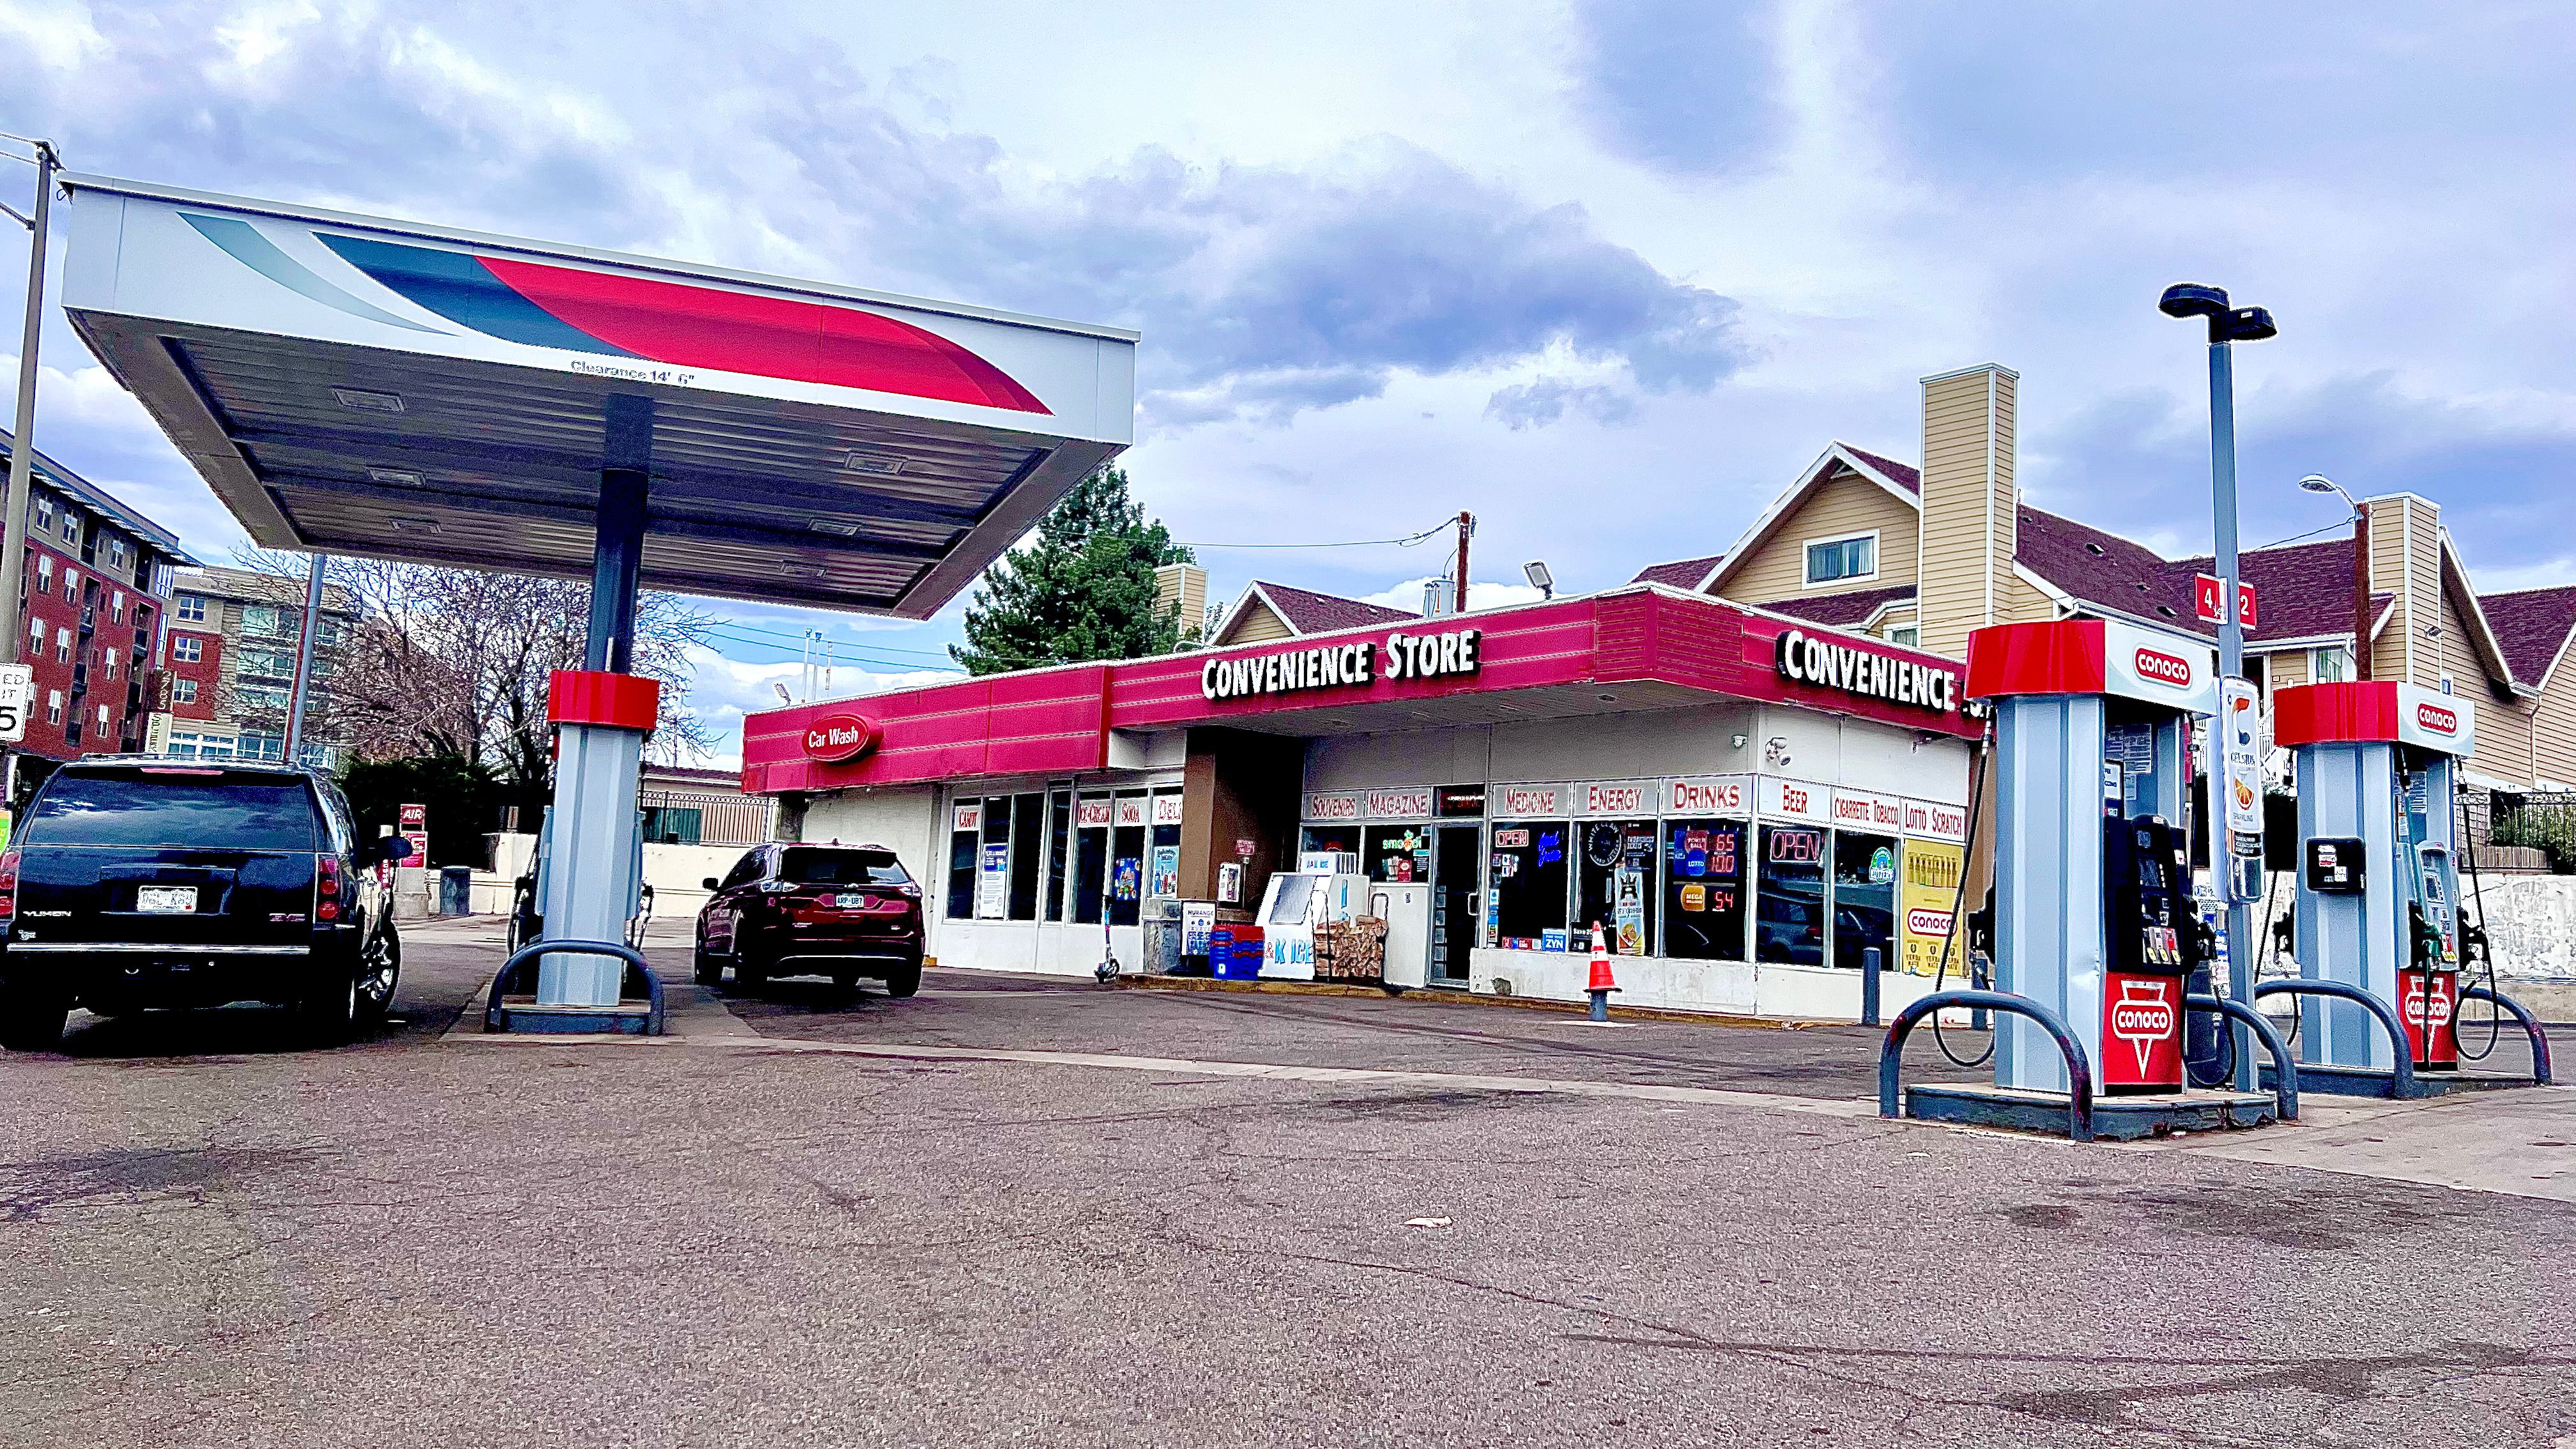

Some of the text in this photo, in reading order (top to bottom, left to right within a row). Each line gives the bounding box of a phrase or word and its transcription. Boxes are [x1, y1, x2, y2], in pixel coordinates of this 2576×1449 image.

[571, 360, 647, 379] Clearance
[2204, 588, 2213, 609] 4
[2239, 595, 2250, 616] 2
[1202, 629, 1475, 700] CONVENIENCE STORE
[1784, 630, 1956, 712] CONVENIENCE
[157, 671, 171, 710] 2785
[808, 725, 859, 748] Car Wash
[1368, 792, 1428, 815] MAGAZINE
[1505, 787, 1554, 813] MEDICINE
[1588, 785, 1644, 811] ENERGY
[1673, 782, 1740, 809] DRINKS
[1782, 784, 1807, 814] BEER
[403, 809, 422, 820] AIR
[959, 809, 978, 828] CANDY
[1121, 802, 1140, 824] SODA
[1158, 799, 1181, 820] DELI
[1873, 800, 1899, 826] TOBACCO
[1905, 803, 1962, 836] LOTTO SCRATCH
[1496, 832, 1527, 846] OPEN
[1716, 833, 1735, 852] 65
[1772, 832, 1818, 860] OPEN
[1715, 891, 1734, 910] 54
[1545, 939, 1563, 949] ZYN
